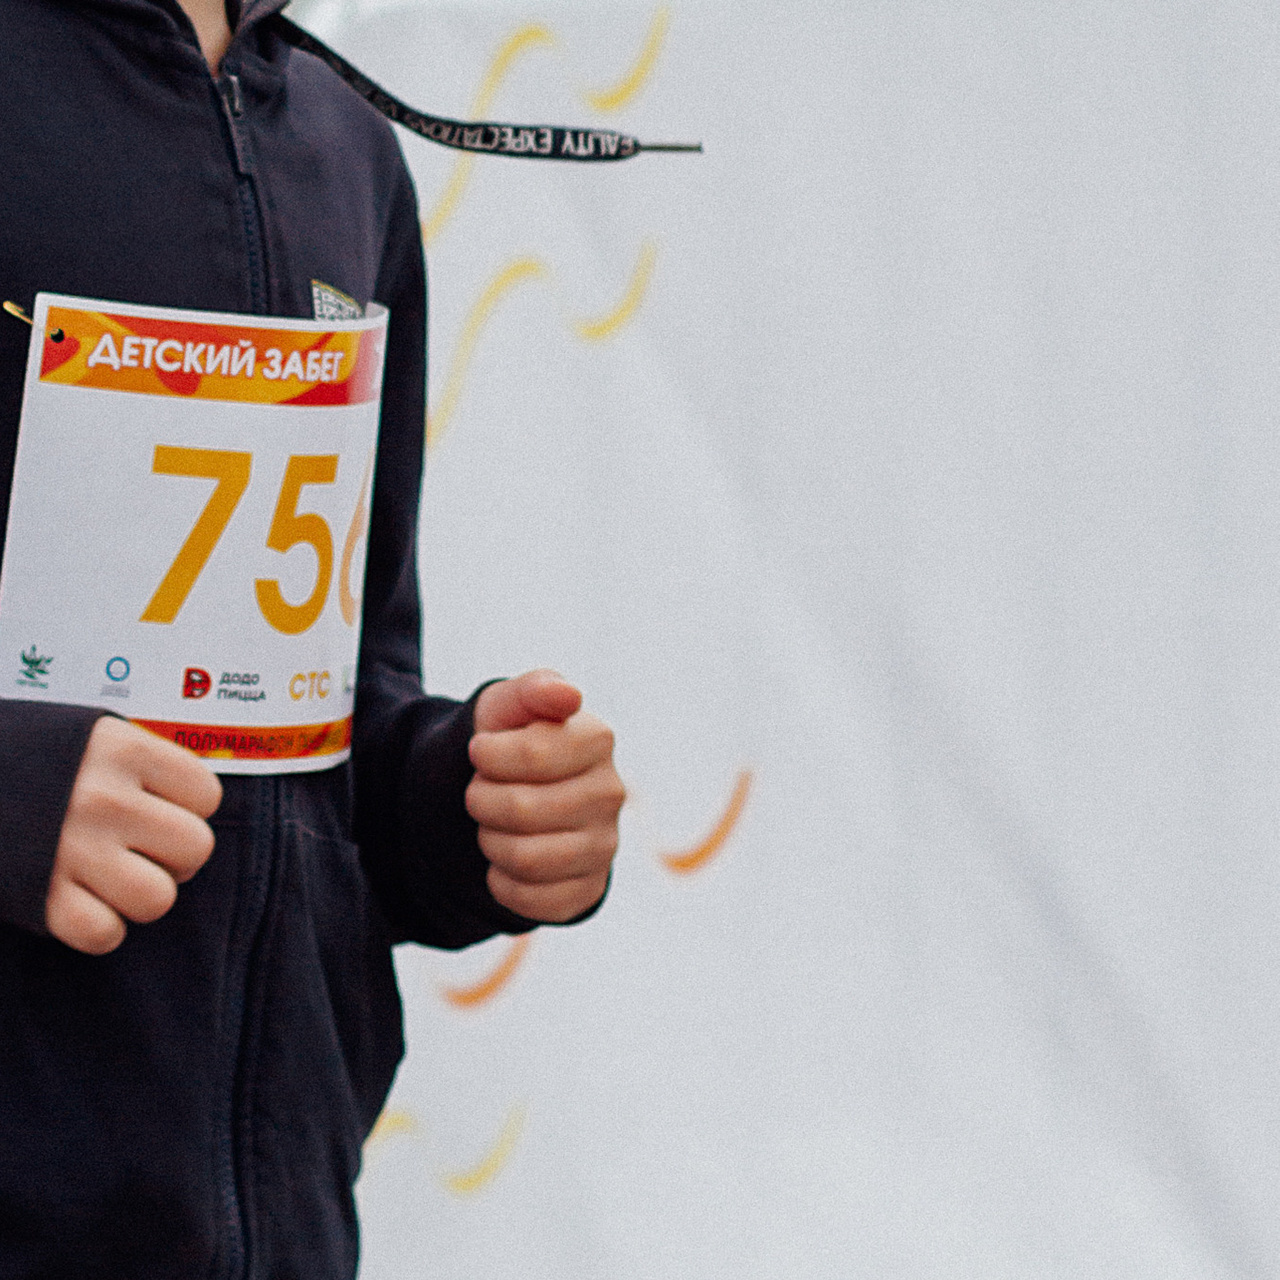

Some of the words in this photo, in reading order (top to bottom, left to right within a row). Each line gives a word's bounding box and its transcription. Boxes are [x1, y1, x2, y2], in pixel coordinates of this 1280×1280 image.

[86, 331, 256, 378] ДЕТСКИЙ
[262, 348, 344, 383] ЗАБЕГ
[219, 672, 261, 687] ДОДО
[288, 670, 331, 702] СТС
[217, 687, 267, 702] ПИЦЦА
